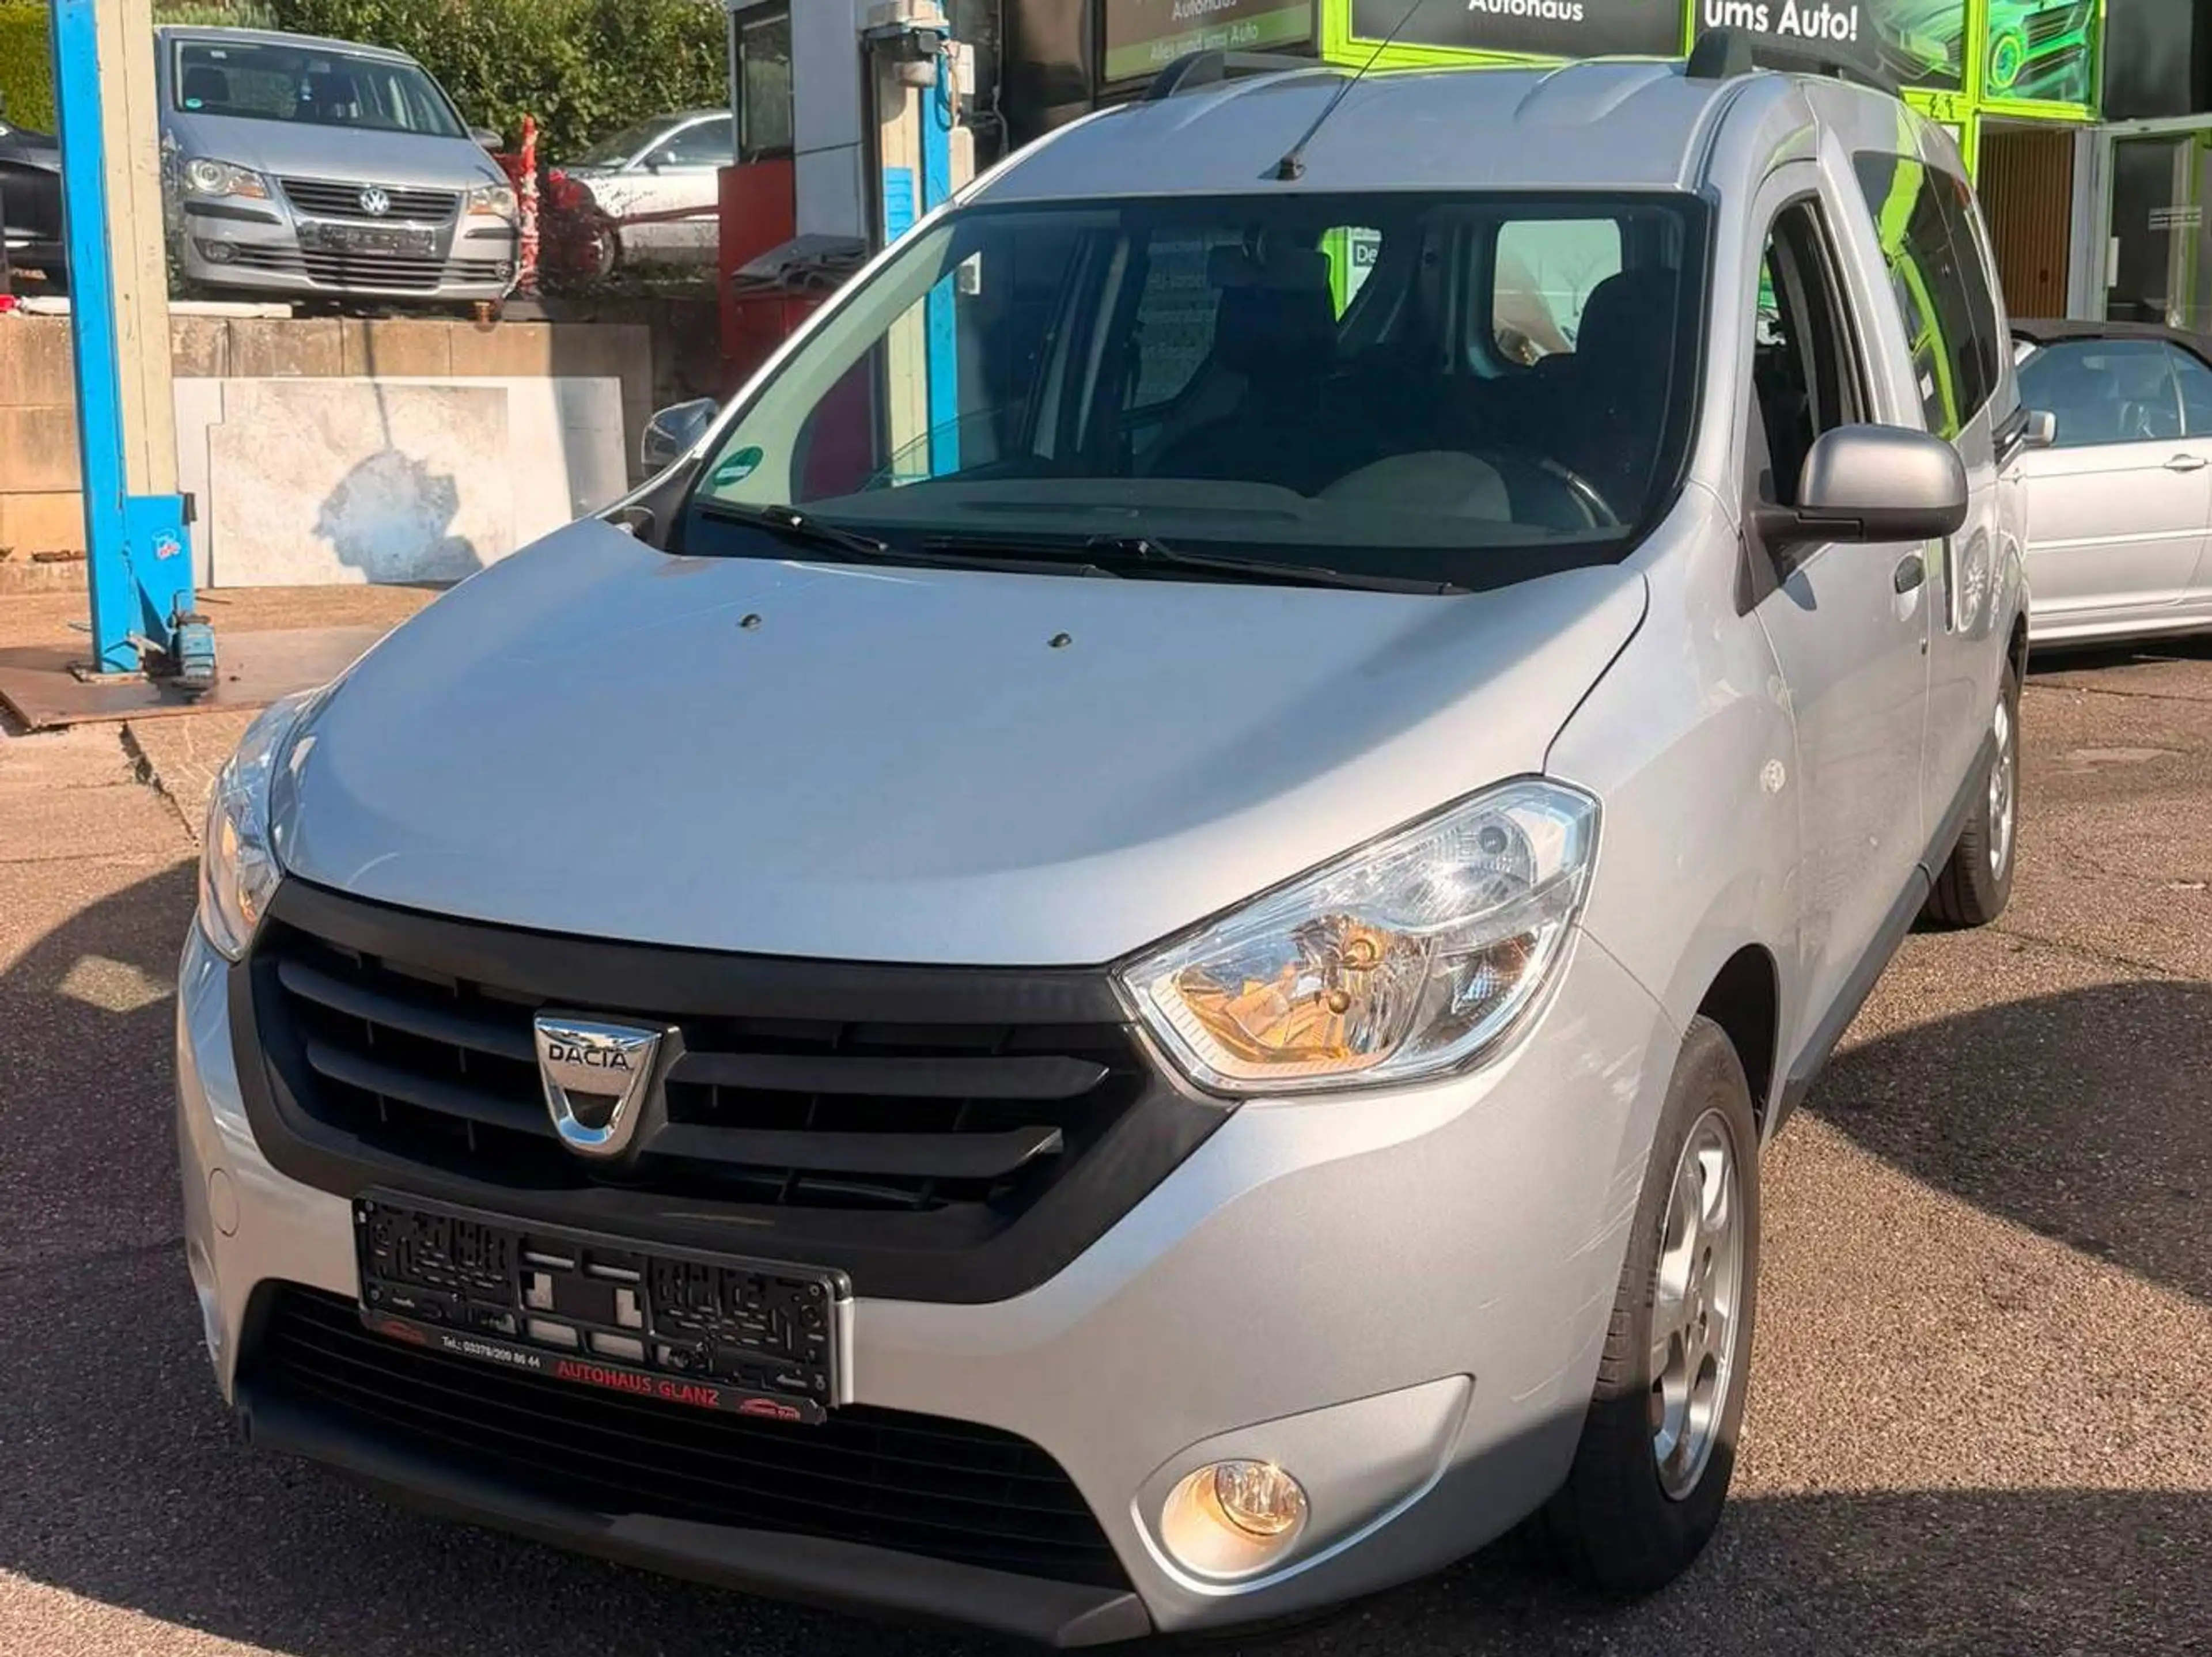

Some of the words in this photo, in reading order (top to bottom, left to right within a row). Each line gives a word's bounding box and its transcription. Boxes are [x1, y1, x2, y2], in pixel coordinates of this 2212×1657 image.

[1704, 0, 1768, 32] ums
[1777, 0, 1857, 41] Auto!
[549, 1045, 630, 1070] DACIA
[557, 1359, 652, 1393] AUTOHAUS
[658, 1380, 719, 1406] GLANZ
